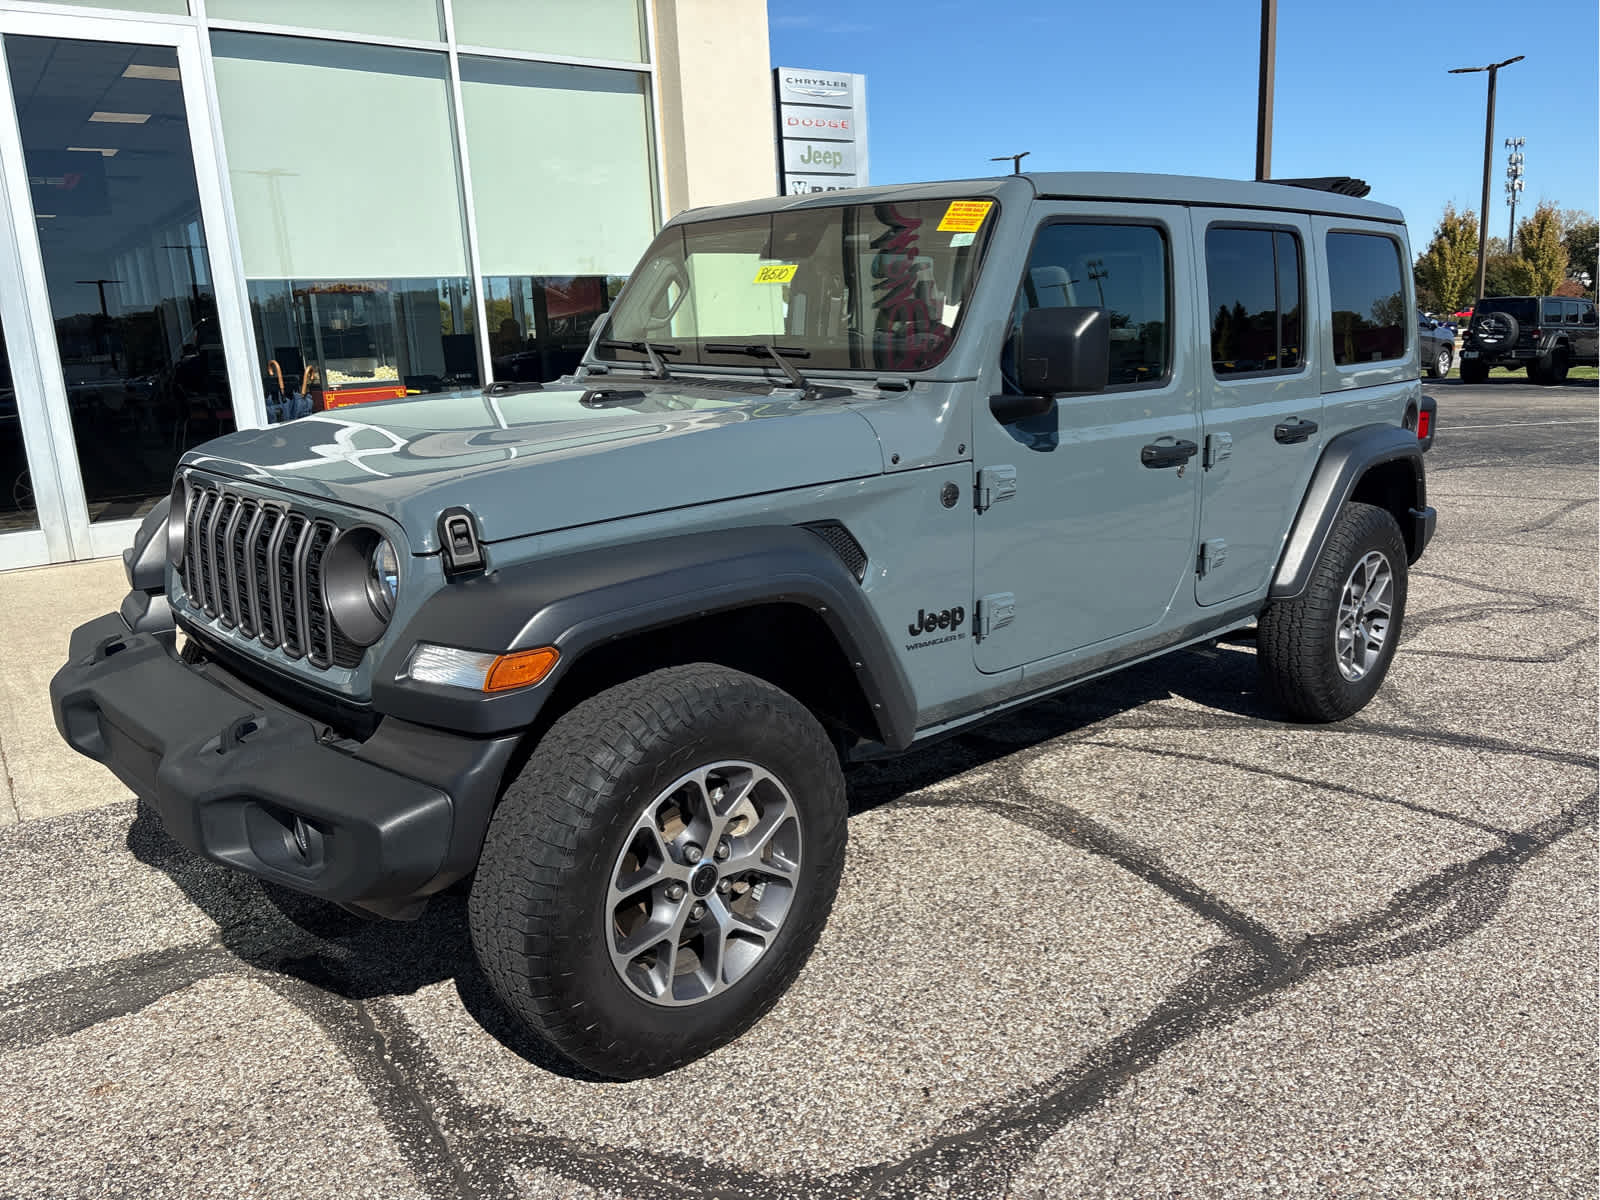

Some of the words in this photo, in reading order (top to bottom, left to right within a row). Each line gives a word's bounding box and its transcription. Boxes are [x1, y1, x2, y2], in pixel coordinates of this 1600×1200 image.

[785, 77, 847, 88] CHRYSLER
[787, 117, 849, 129] DODGE
[800, 145, 843, 168] Jeep
[908, 606, 965, 636] Jeep
[905, 635, 956, 651] WRANGLER
